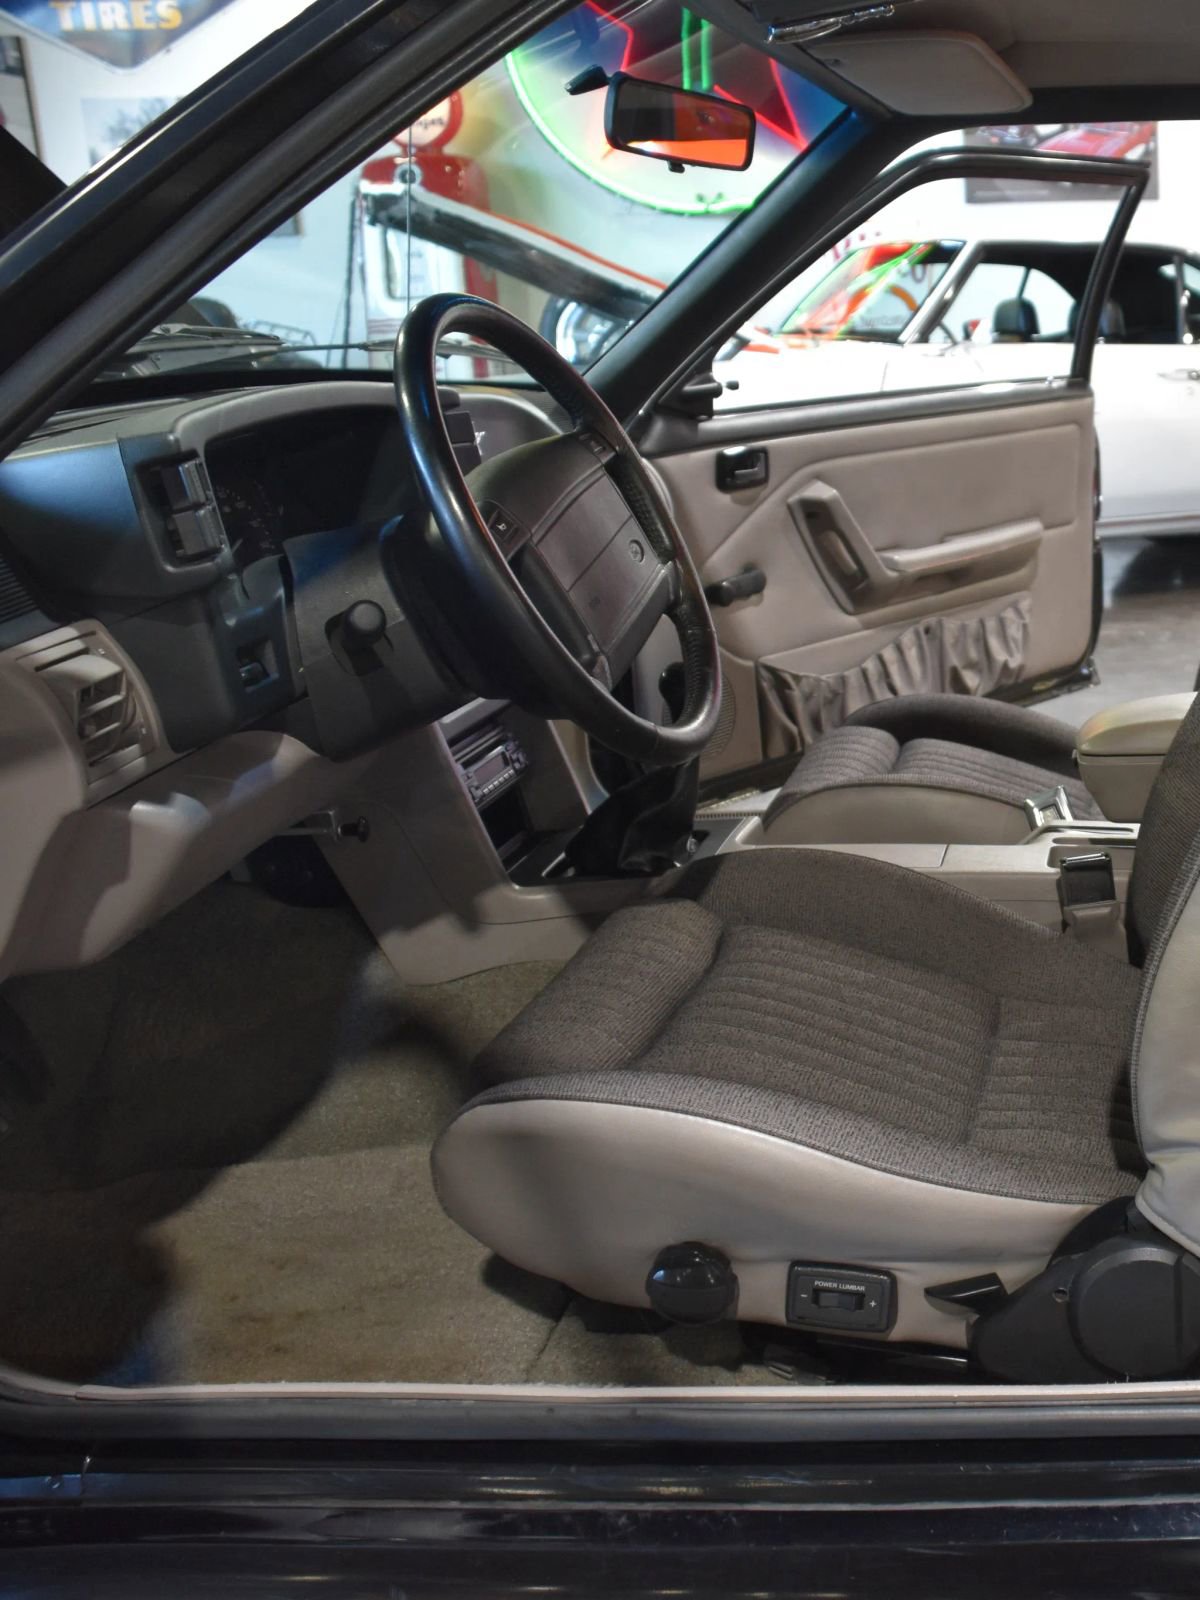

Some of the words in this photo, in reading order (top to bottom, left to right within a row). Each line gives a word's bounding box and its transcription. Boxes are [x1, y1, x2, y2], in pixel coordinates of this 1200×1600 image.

[49, 0, 182, 31] TIRES
[814, 1280, 838, 1288] POWER
[839, 1283, 866, 1291] LUMBAR
